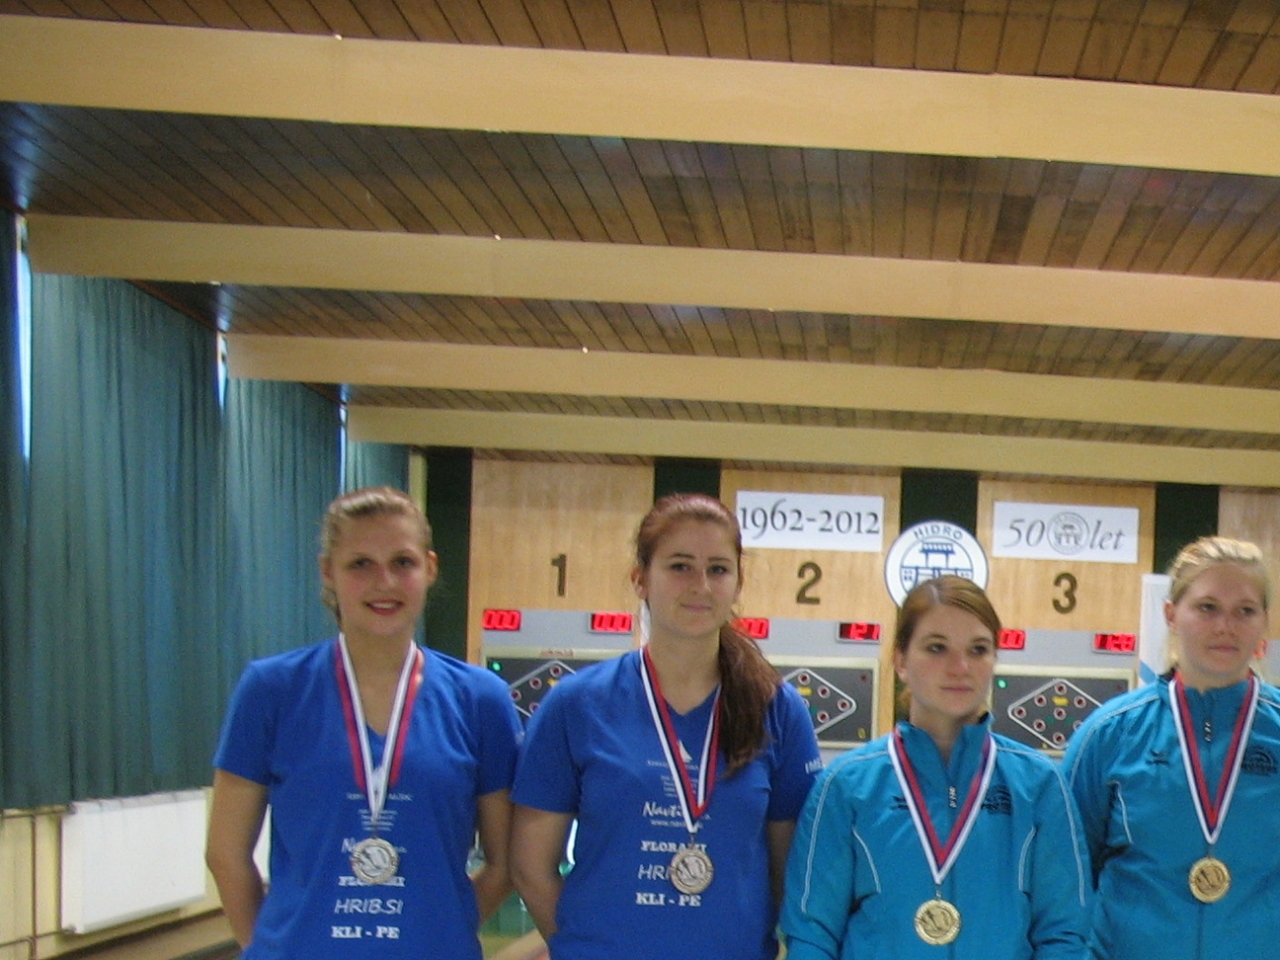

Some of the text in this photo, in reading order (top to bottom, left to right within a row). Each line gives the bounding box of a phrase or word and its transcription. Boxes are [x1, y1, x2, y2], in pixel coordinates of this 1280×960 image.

[740, 499, 880, 540] 1962-2012
[913, 524, 963, 540] HIDRO
[1003, 518, 1046, 548] 50
[1089, 520, 1125, 550] let
[551, 554, 566, 597] 1
[796, 561, 822, 605] 2
[1053, 572, 1078, 614] 3
[635, 892, 665, 906] KLI
[678, 894, 702, 907] PE
[331, 925, 363, 939] KLI
[375, 926, 400, 940] PE
